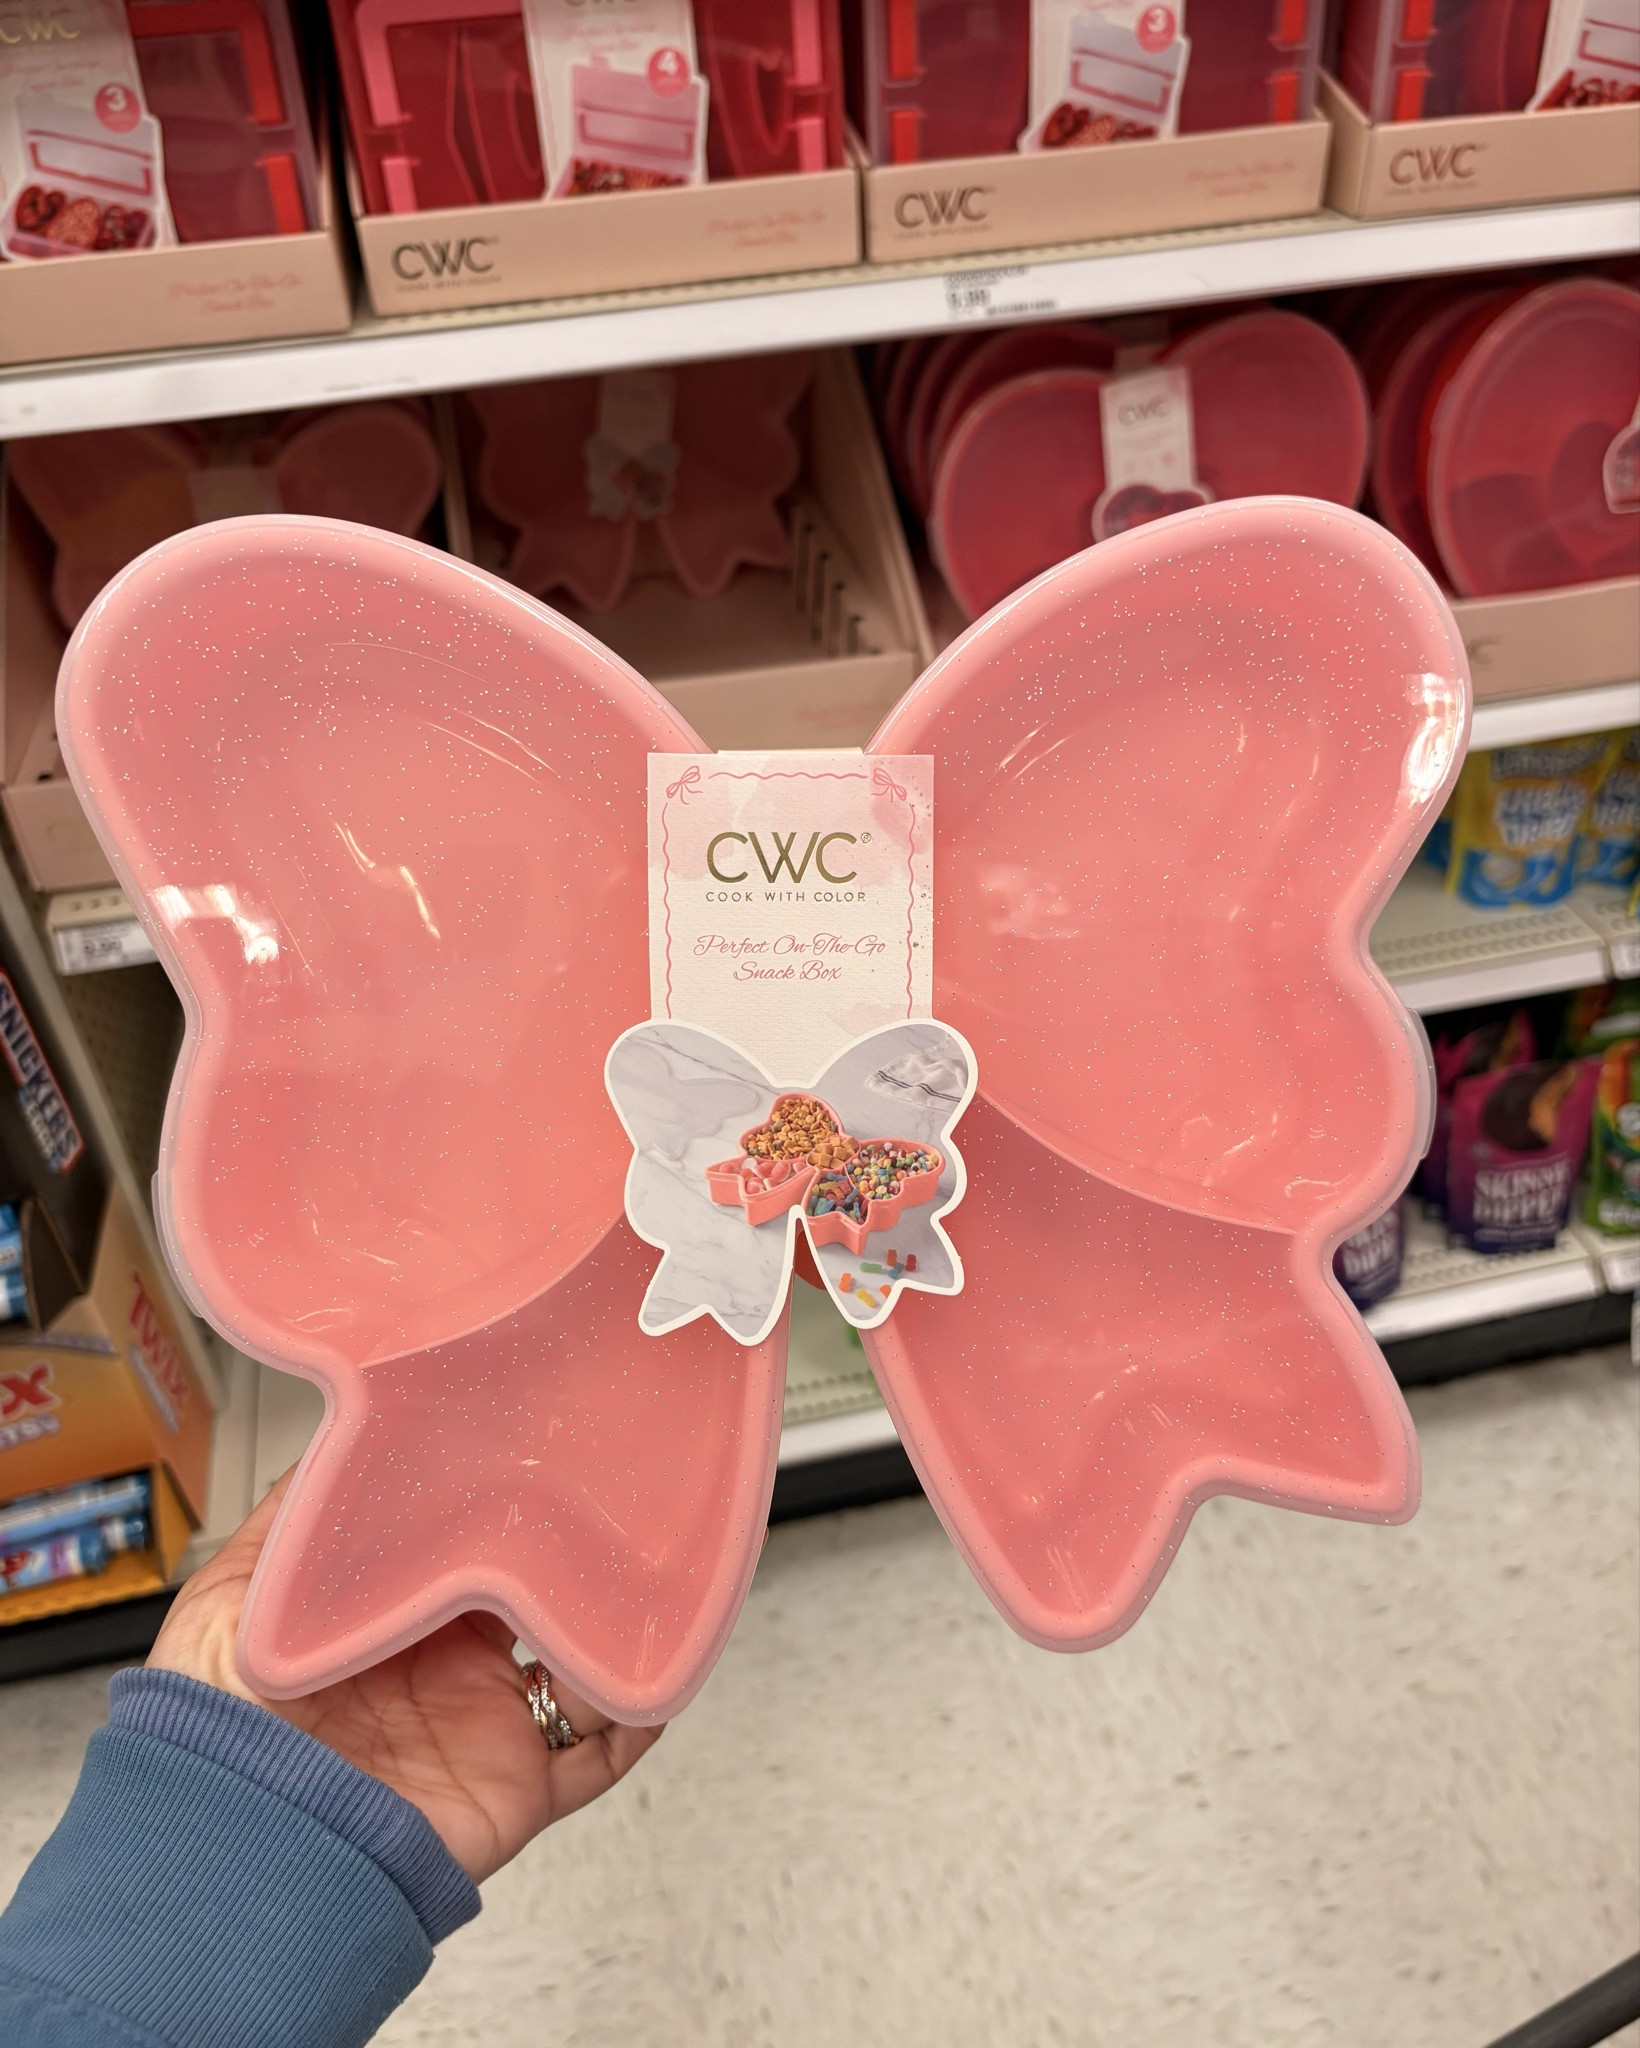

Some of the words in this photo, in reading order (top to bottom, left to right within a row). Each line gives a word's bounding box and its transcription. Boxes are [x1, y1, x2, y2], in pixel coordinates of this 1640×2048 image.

[1147, 8, 1167, 33] 3
[657, 51, 679, 75] 4
[105, 86, 127, 112] 3
[1388, 144, 1477, 185] CWC
[895, 186, 990, 228] CWC
[390, 237, 496, 280] CWC
[706, 891, 754, 903] COOK
[764, 891, 805, 902] WITH
[813, 891, 867, 903] COLOR
[693, 934, 771, 960] Perfect
[733, 960, 796, 982] Snack
[799, 959, 843, 982] Box
